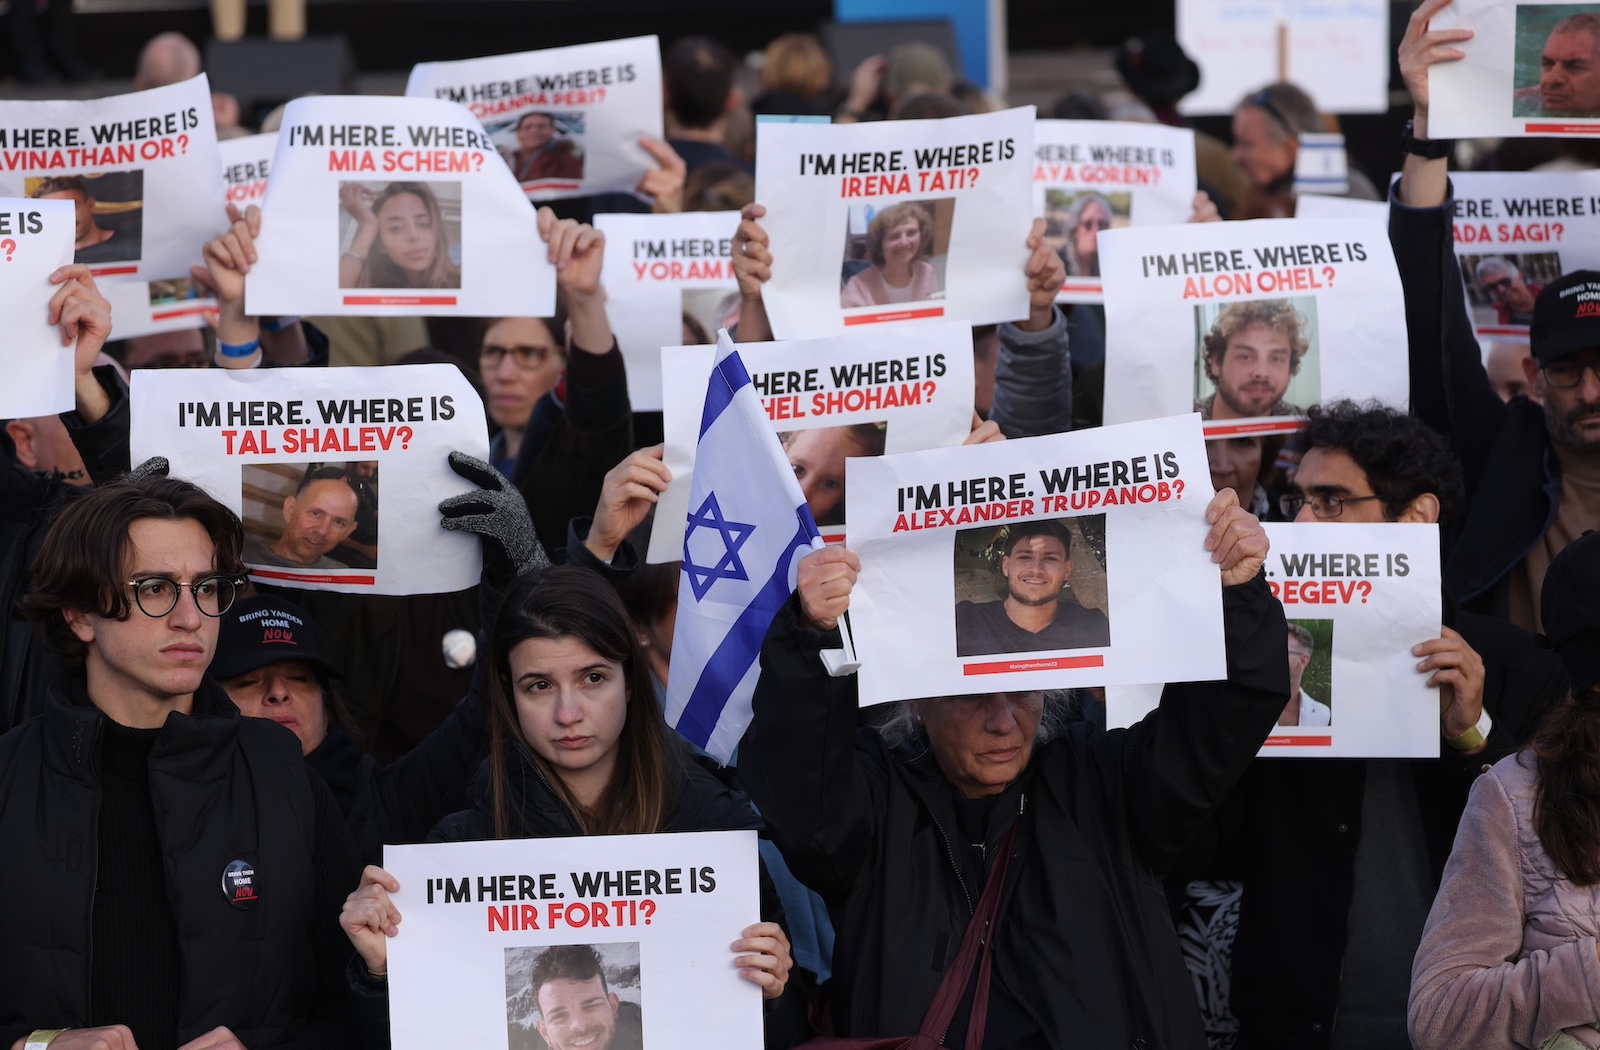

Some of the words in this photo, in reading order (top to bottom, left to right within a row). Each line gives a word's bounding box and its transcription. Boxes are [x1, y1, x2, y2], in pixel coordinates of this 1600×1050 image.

[536, 67, 612, 91] WHERE
[618, 64, 636, 82] IS
[13, 127, 85, 148] HERE.
[91, 113, 177, 145] WHERE
[182, 107, 199, 129] IS
[290, 125, 323, 146] I'M
[330, 126, 402, 147] HERE.
[407, 126, 493, 151] WHERE
[0, 145, 135, 171] VINATHAN
[140, 134, 189, 160] OR?
[328, 151, 376, 172] MIA
[382, 151, 484, 172] SCHEM?
[800, 154, 835, 175] I'M
[841, 151, 907, 174] HERE.
[915, 143, 993, 168] WHERE
[999, 138, 1015, 160] IS
[841, 174, 912, 197] IRENA
[918, 167, 980, 192] TATI?
[1032, 164, 1076, 182] AYA
[1453, 199, 1499, 217] ERE.
[1503, 197, 1585, 217] WHERE
[18, 211, 43, 234] IS
[1498, 222, 1564, 243] SAGI?
[633, 239, 667, 259] I'M
[1142, 255, 1178, 277] I'M
[1182, 249, 1252, 273] HERE.
[1254, 243, 1343, 268] WHERE
[1346, 242, 1367, 262] IS
[633, 260, 722, 281] YORAM
[1182, 273, 1253, 299] ALON
[1257, 266, 1336, 292] OHEL?
[753, 369, 824, 396] HERE.
[830, 357, 919, 388] WHERE
[925, 353, 947, 377] IS
[178, 401, 221, 427] I'M
[227, 400, 311, 426] HERE.
[318, 397, 423, 424] WHERE
[431, 396, 455, 420] IS
[761, 395, 805, 421] HEL
[811, 380, 936, 416] SHOHAM?
[222, 430, 276, 454] TAL
[282, 426, 413, 454] SHALEV?
[898, 484, 942, 512] I'M
[948, 473, 1035, 507] HERE.
[1040, 456, 1147, 494] WHERE
[1153, 451, 1180, 479] IS
[893, 500, 1034, 532] ALEXANDER
[1041, 479, 1185, 514] TRUPANOB?
[1280, 553, 1379, 577] WHERE
[1386, 553, 1410, 577] IS
[239, 609, 269, 623] BRING
[270, 609, 303, 626] YARDEN
[261, 619, 290, 629] HOME
[264, 628, 293, 640] NOW
[1010, 661, 1057, 669] #bringthemhome23
[234, 877, 252, 885] HOME
[236, 886, 253, 898] NOW
[426, 877, 471, 904] I'M
[477, 874, 565, 902] HERE.
[571, 868, 682, 898] WHERE
[690, 866, 716, 893] IS
[487, 905, 539, 932] NIR
[548, 899, 656, 929] FORTI?
